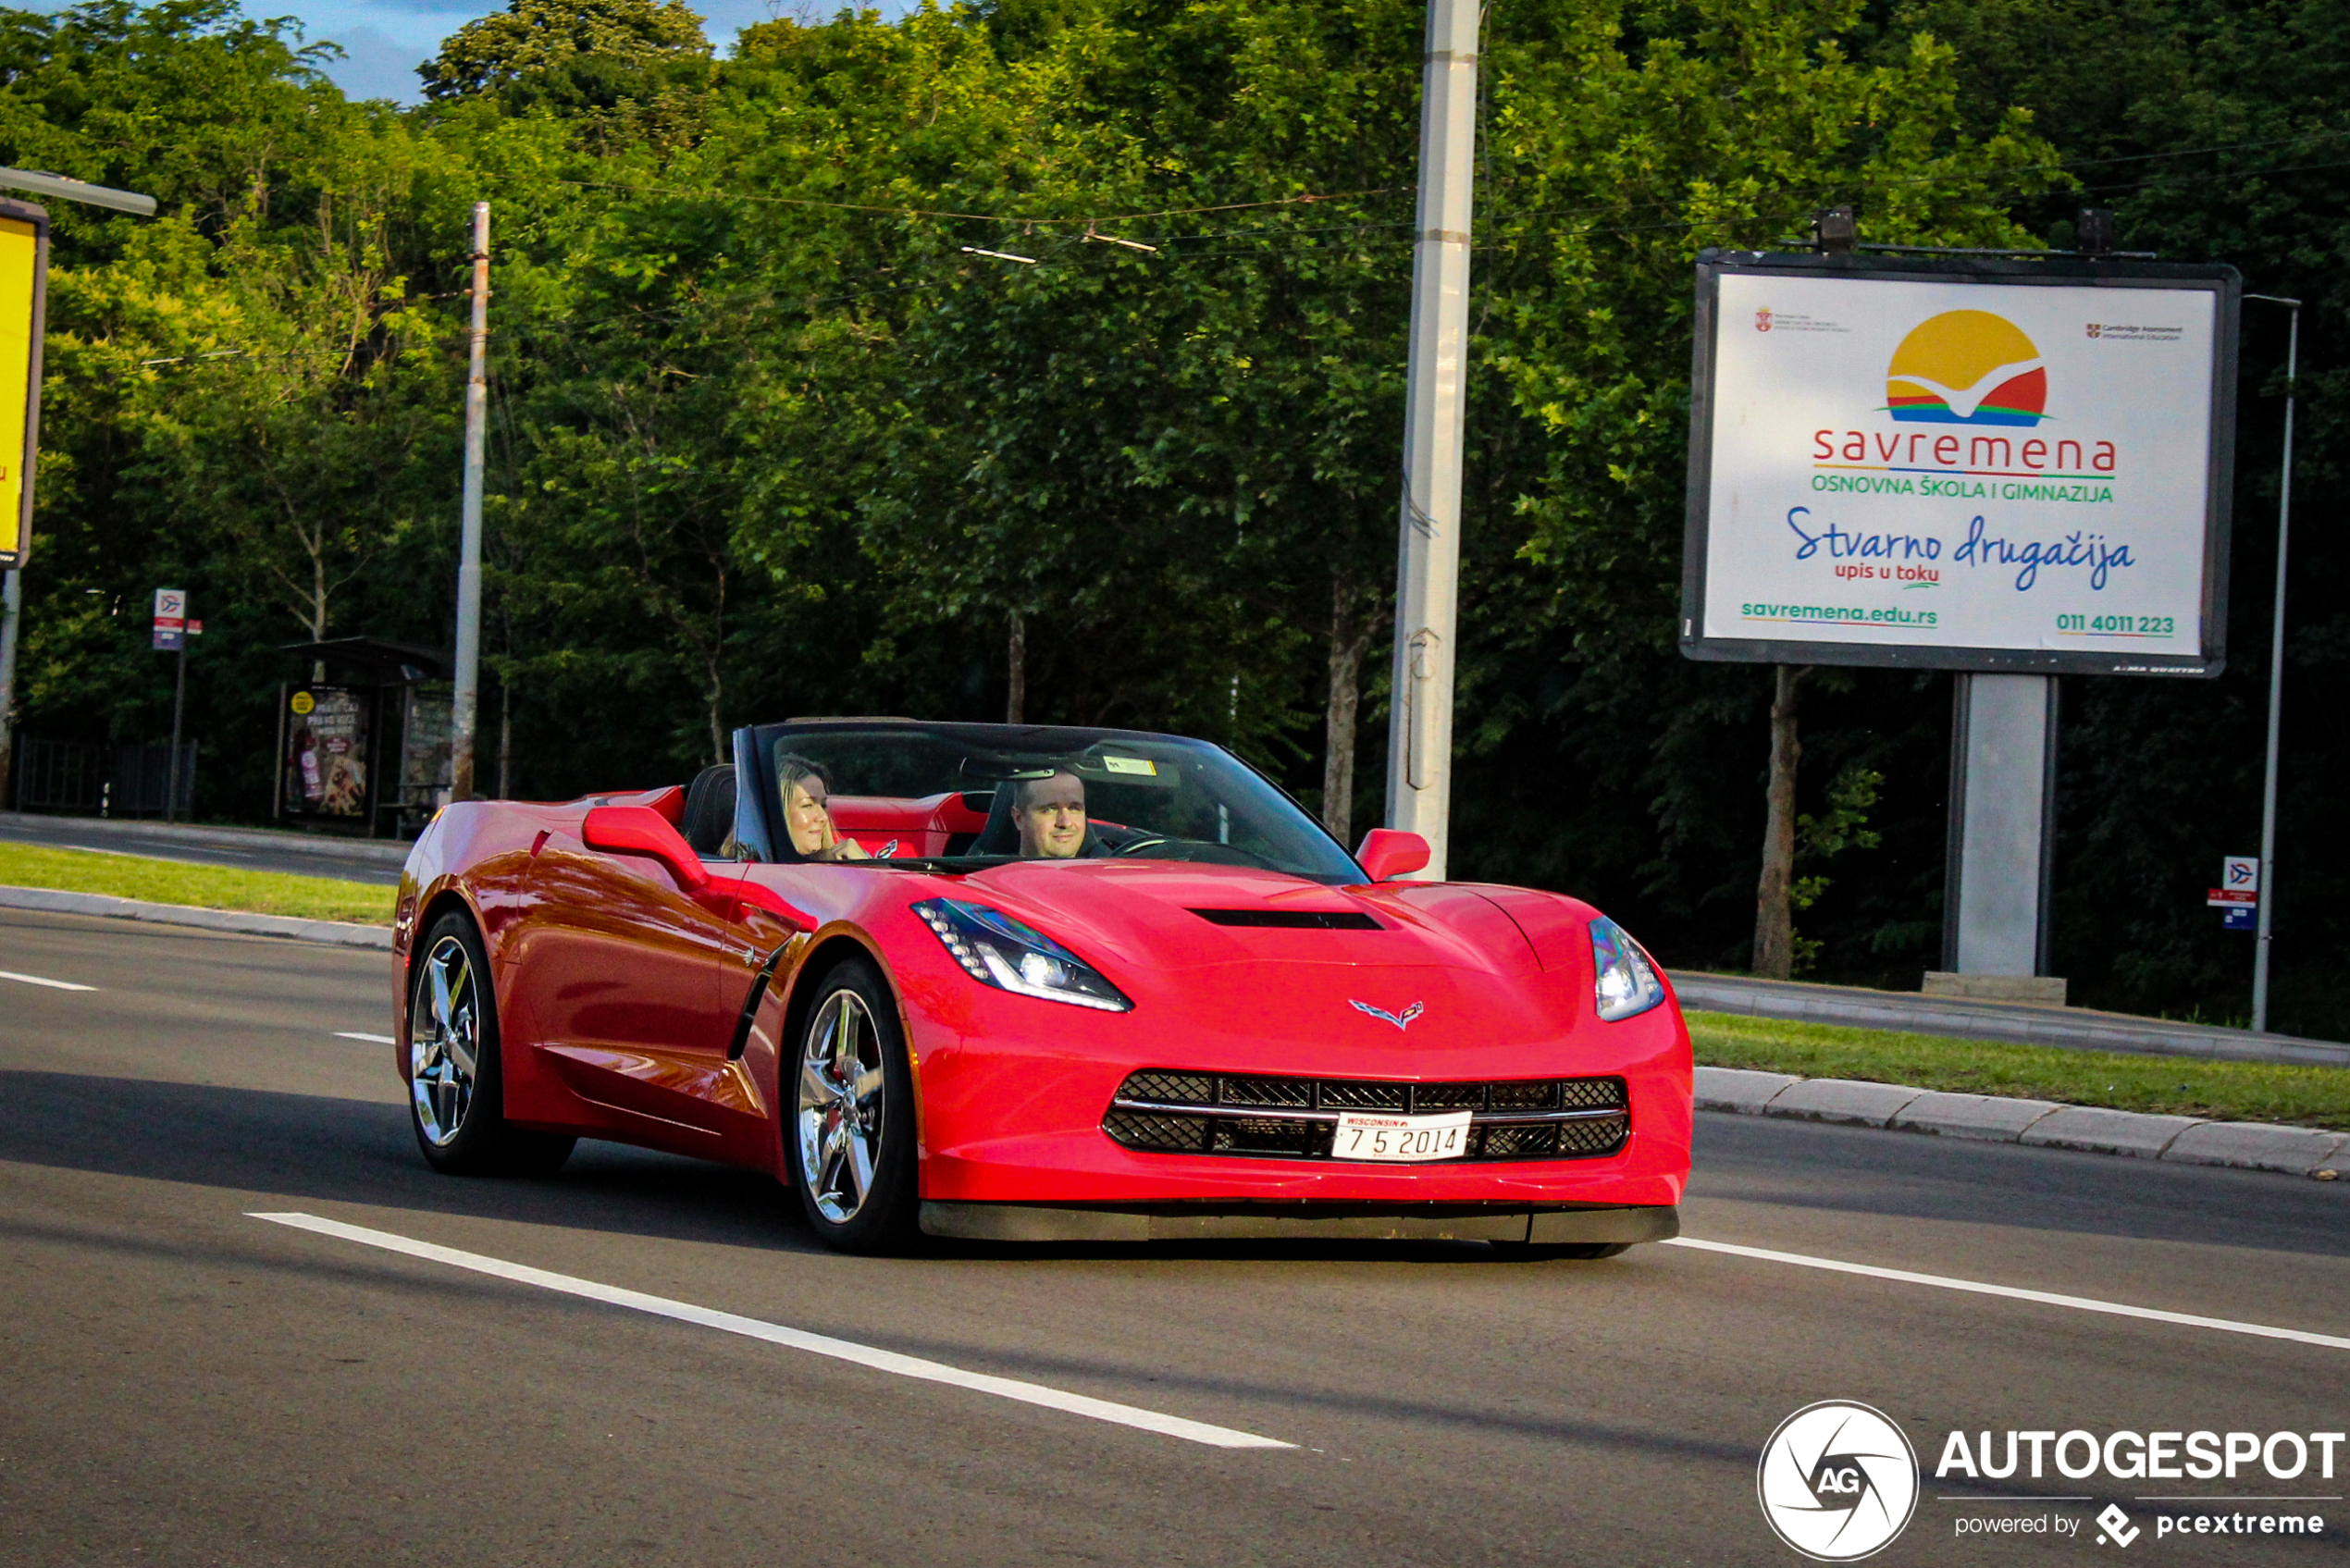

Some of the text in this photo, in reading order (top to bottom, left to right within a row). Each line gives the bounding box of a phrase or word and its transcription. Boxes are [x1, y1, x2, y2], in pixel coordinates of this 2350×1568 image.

[1812, 429, 2116, 472] savremena
[1812, 475, 2114, 503] OSNOVNA ŠKOLA I GIMNAZIJA
[1787, 506, 2136, 592] Stvarno drugačija
[1835, 563, 1939, 582] upis u toku
[1741, 602, 1937, 623] savremena.edu.rs
[2057, 614, 2174, 634] 011 4011 223
[1347, 1117, 1400, 1128] WISCONSIN
